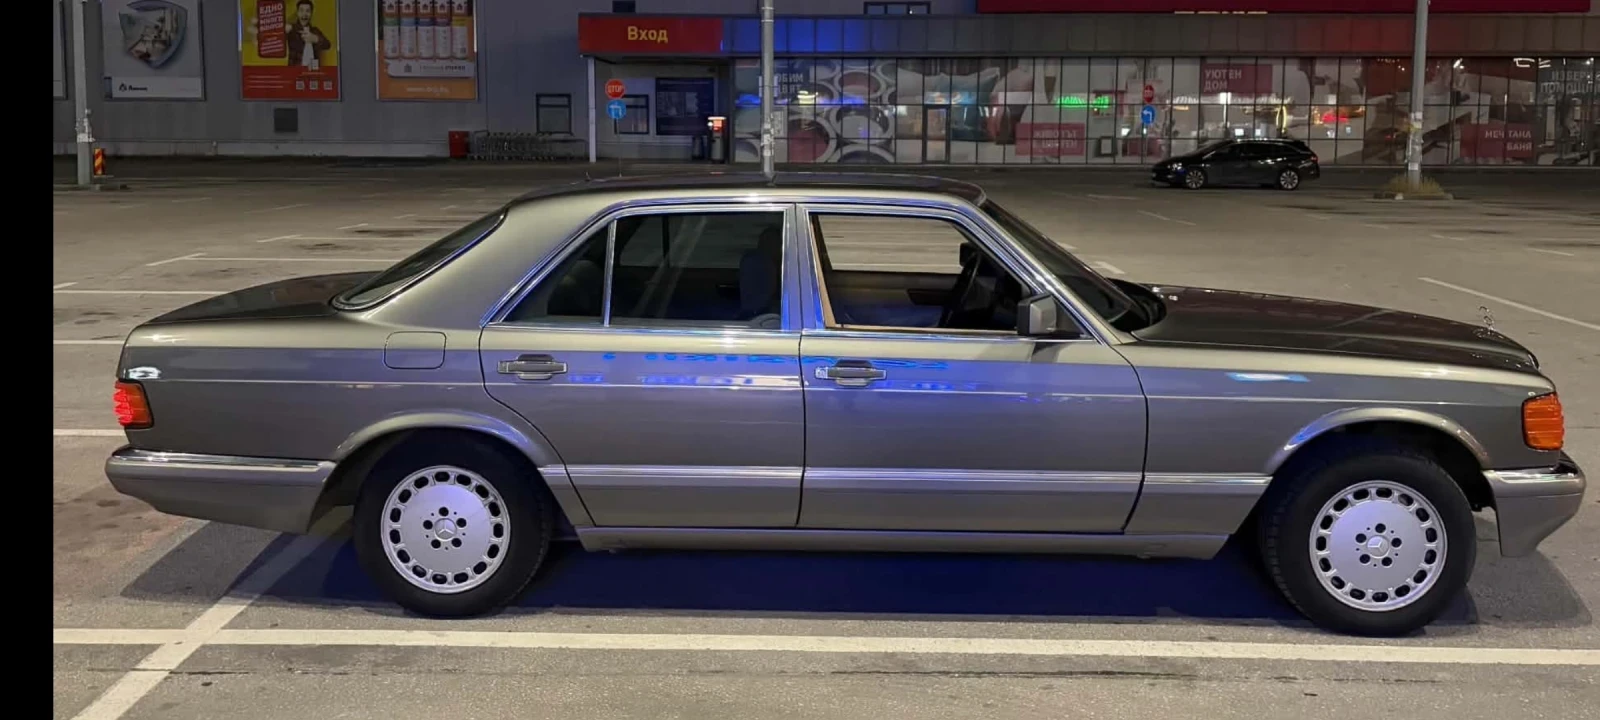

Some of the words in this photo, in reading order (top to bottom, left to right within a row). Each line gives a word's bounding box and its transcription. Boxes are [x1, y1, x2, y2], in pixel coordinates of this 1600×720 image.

[260, 2, 283, 14] ЕДНО
[627, 26, 668, 43] Вход
[1204, 69, 1242, 79] УЮТЕН
[607, 85, 624, 93] STOP
[1204, 82, 1228, 92] ДОМ
[1506, 142, 1532, 151] БАНЯ
